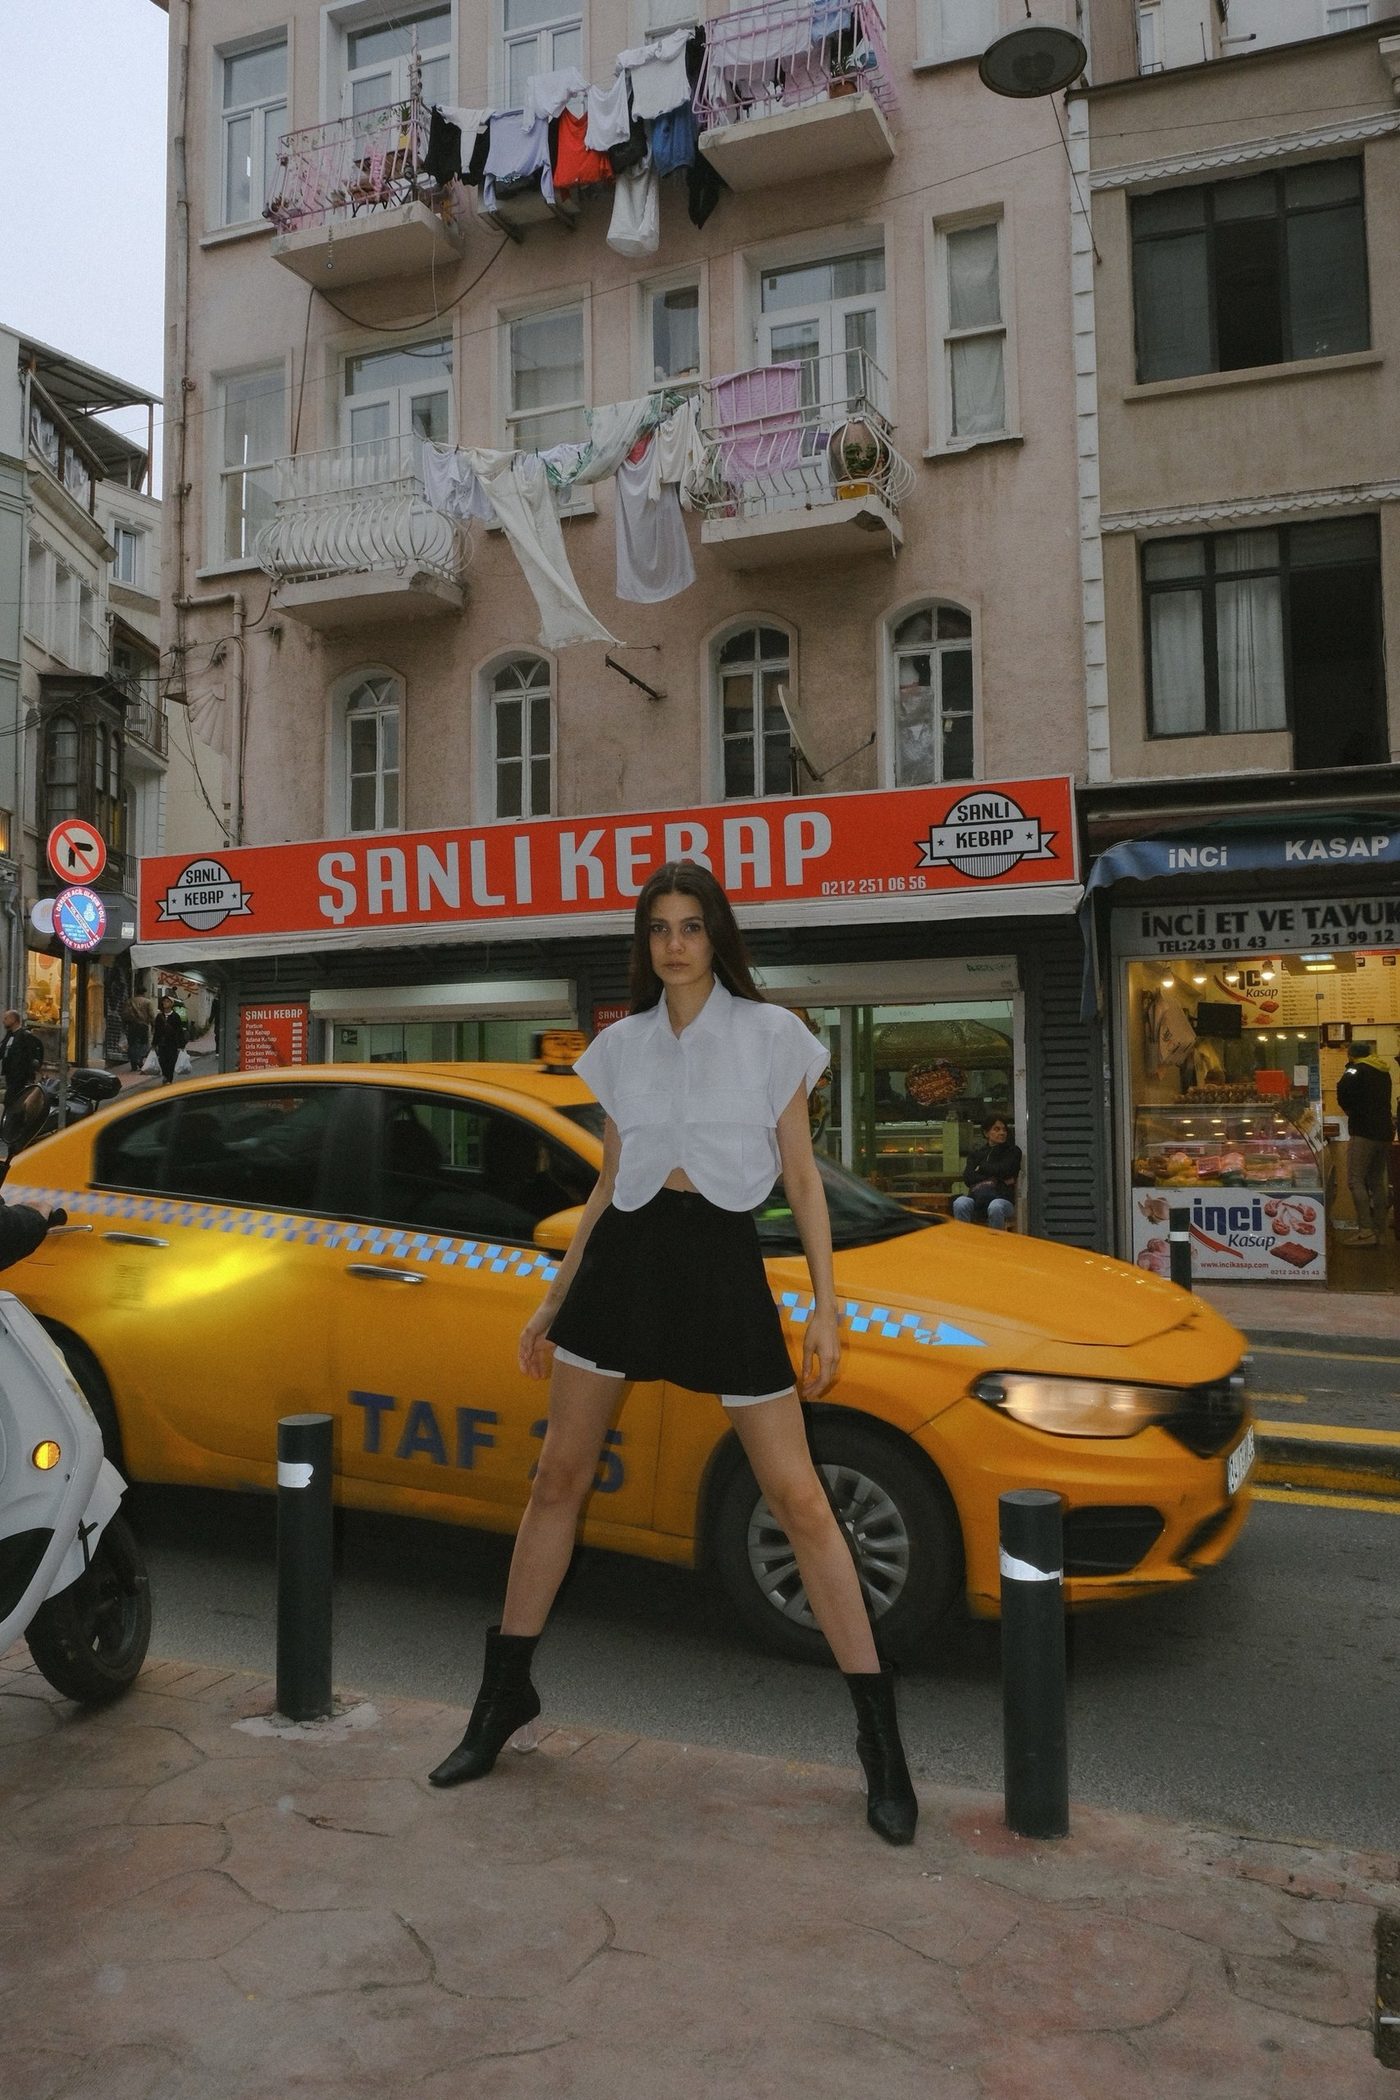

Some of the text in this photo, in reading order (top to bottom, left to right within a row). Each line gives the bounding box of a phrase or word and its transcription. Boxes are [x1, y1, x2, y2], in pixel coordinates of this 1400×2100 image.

[957, 802, 1010, 822] ŞANLI
[956, 829, 1014, 848] KEBAP
[1285, 836, 1390, 861] KASAP
[186, 867, 221, 885] ŞANLI
[318, 836, 532, 924] ŞANLI
[821, 875, 927, 896] 0212 251 06 56
[184, 890, 224, 906] KEBAP
[1216, 912, 1249, 934] ET
[1257, 909, 1294, 931] VE
[1302, 902, 1400, 930] TAVUK
[1222, 938, 1240, 950] 01
[1247, 936, 1267, 948] 43
[1311, 932, 1339, 945] 251
[1347, 931, 1367, 943] 99
[1374, 929, 1394, 942] 12
[1246, 988, 1279, 999] Kasap
[273, 1009, 303, 1019] KEBAP
[1228, 1234, 1276, 1250] Kasap
[1200, 1261, 1269, 1269] www.incikasap.com
[347, 1390, 499, 1470] TAF
